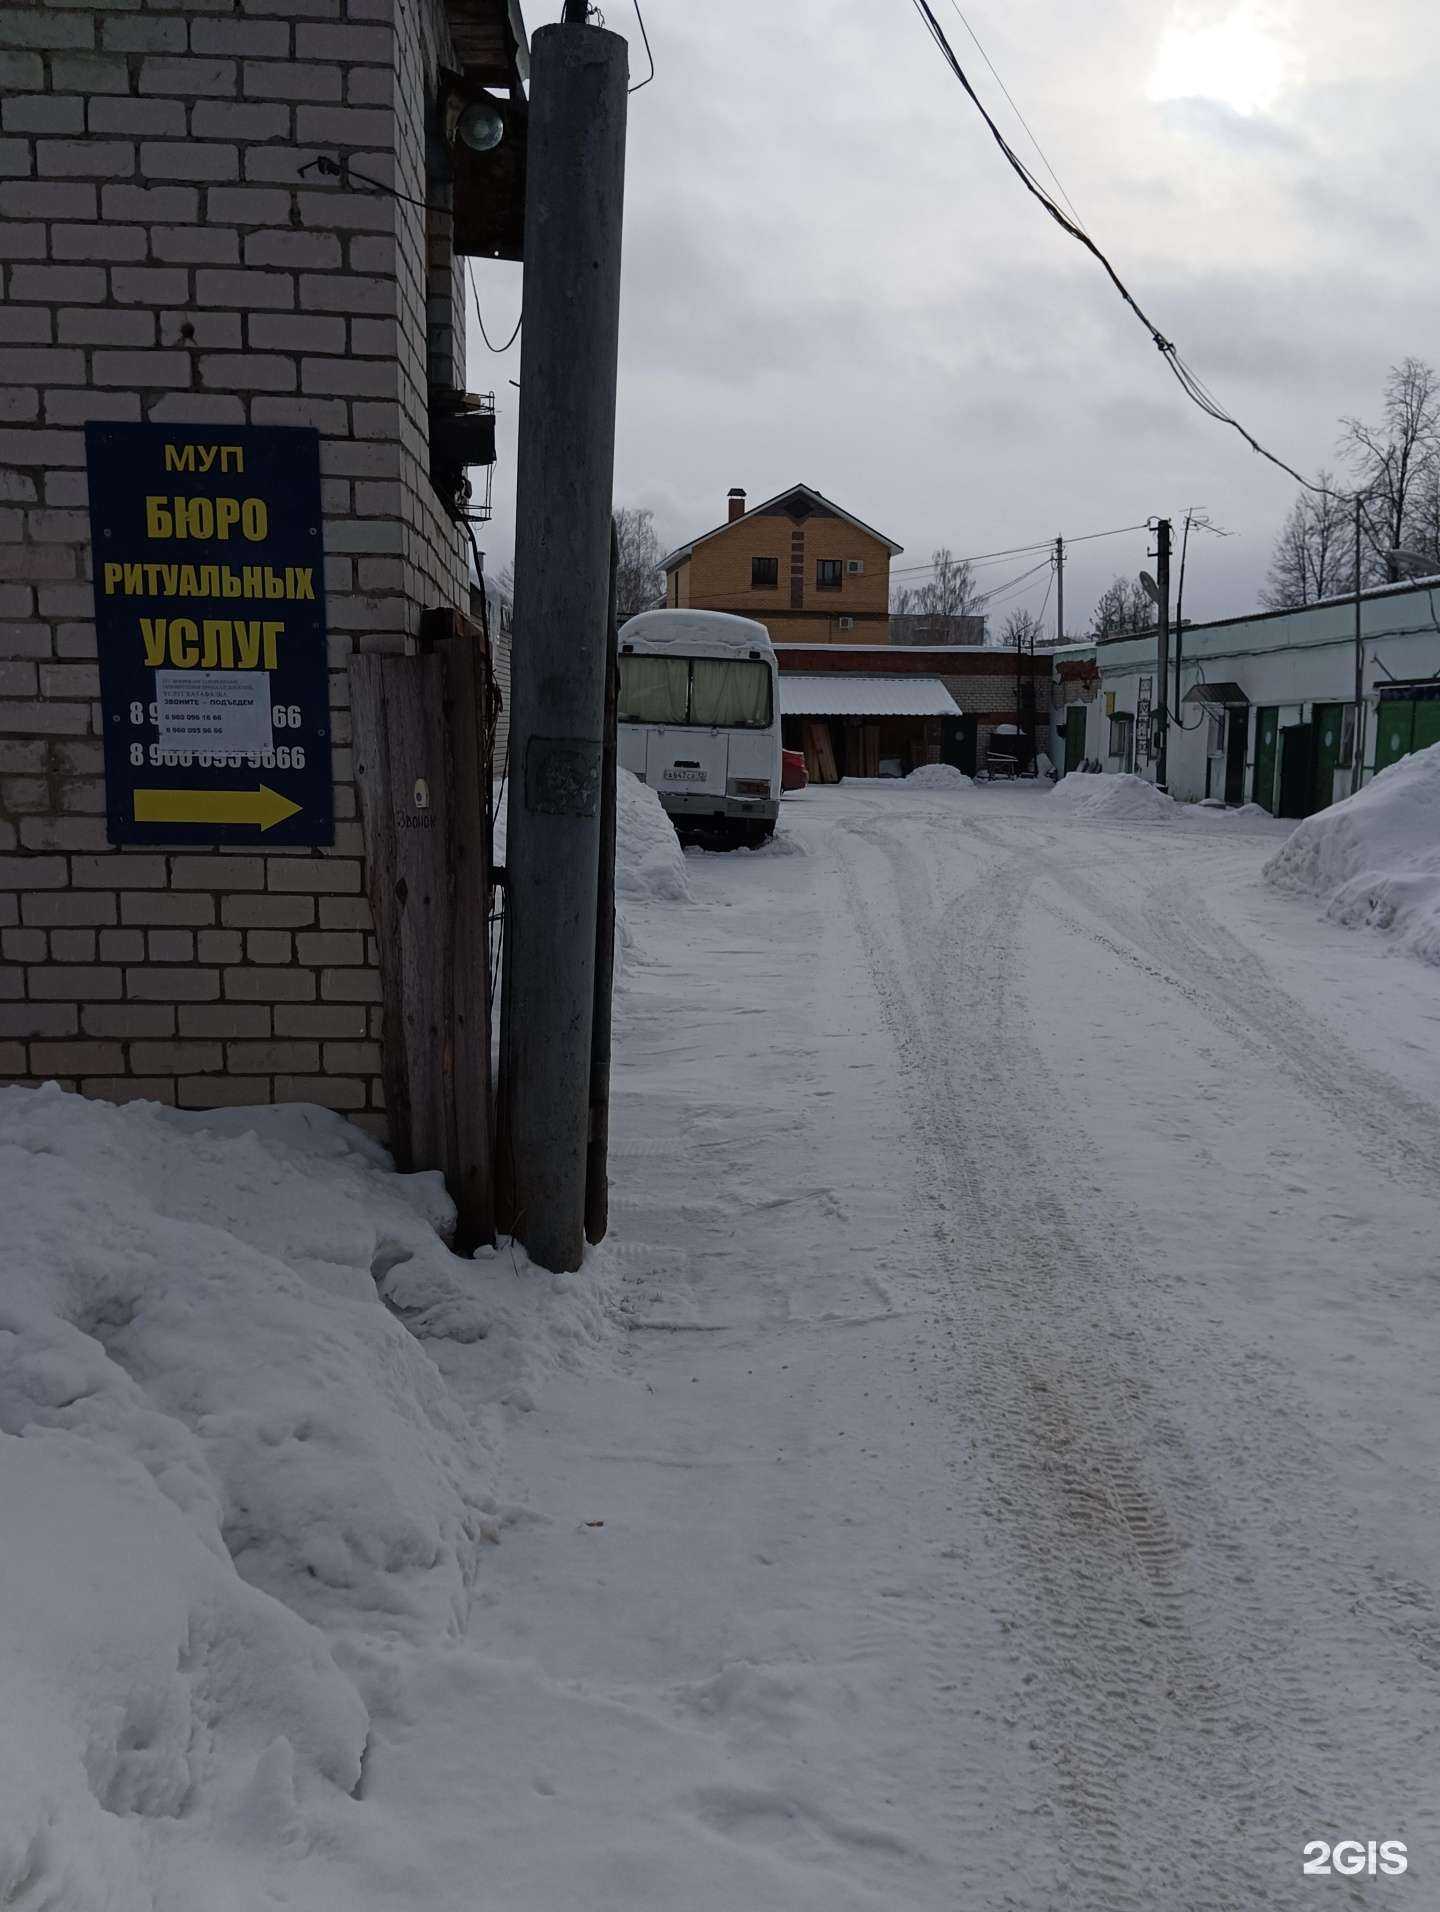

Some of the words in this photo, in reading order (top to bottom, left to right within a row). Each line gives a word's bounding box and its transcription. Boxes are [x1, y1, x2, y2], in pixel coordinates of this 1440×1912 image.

[164, 444, 246, 473] МУП
[145, 496, 268, 542] БЮРО
[103, 563, 316, 600] РИТУАЛЬНЫХ
[139, 618, 285, 669] УСЛУГ
[130, 701, 144, 725] 8
[272, 705, 302, 729] 66
[130, 742, 144, 767] 8
